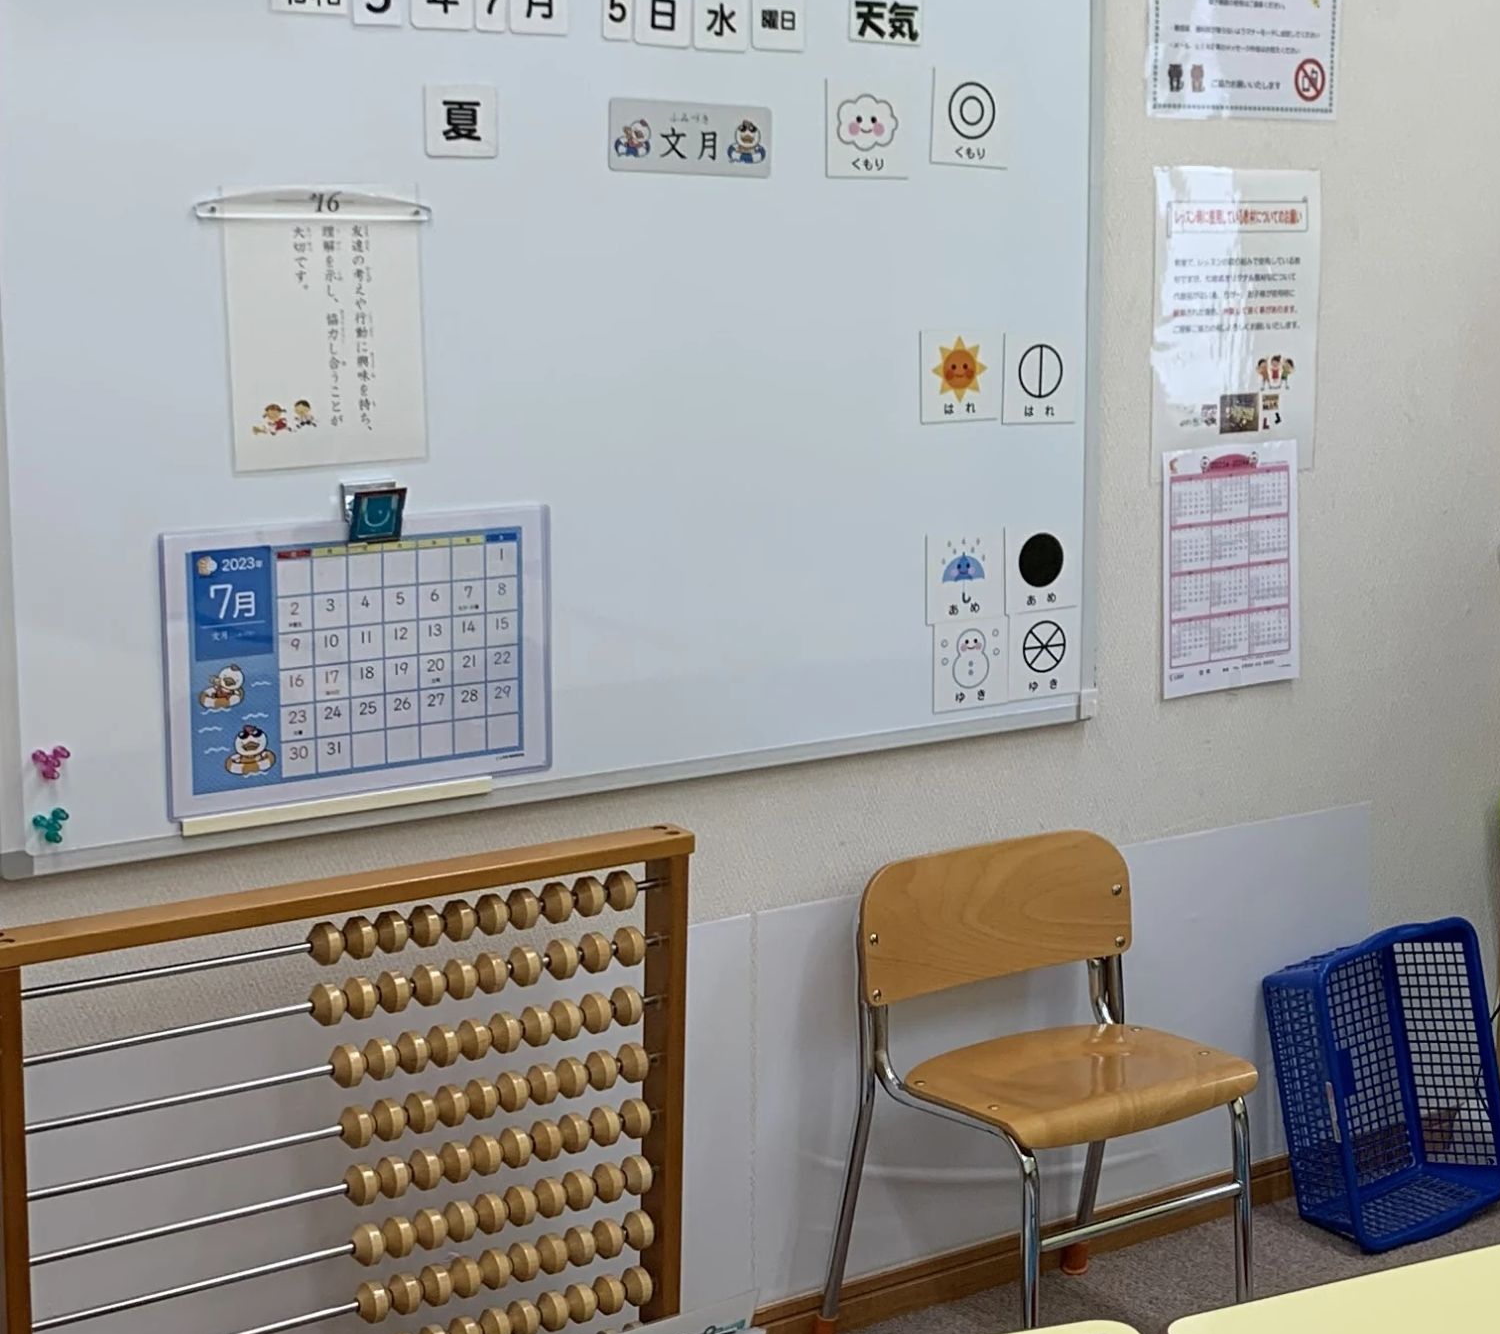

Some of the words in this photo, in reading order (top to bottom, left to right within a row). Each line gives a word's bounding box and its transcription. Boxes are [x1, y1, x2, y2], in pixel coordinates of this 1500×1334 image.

[706, 3, 737, 38] 水
[761, 9, 796, 32] 曜日
[855, 0, 919, 43] 天気
[441, 100, 482, 142] 夏
[659, 127, 719, 162] 文月
[953, 145, 987, 161] くもり
[851, 157, 885, 173] くもり
[943, 402, 977, 415] はれ
[1024, 405, 1055, 418] はれ
[209, 583, 256, 619] 7月
[289, 602, 300, 617] 2
[326, 598, 336, 612] 3
[360, 595, 370, 609] 4
[395, 592, 406, 606] 5
[430, 588, 440, 602] 6
[464, 586, 474, 599] 7
[497, 582, 507, 596] 8
[1025, 592, 1057, 606] あめ
[948, 602, 980, 617] あめ
[289, 638, 300, 651] 9
[323, 634, 339, 648] 10
[360, 630, 372, 644] 11
[393, 627, 408, 641] 12
[428, 624, 443, 637] 13
[461, 621, 476, 634] 14
[495, 617, 510, 631] 15
[289, 675, 304, 688] 16
[324, 670, 340, 684] 17
[360, 666, 375, 680] 18
[394, 663, 409, 676] 19
[427, 659, 445, 673] 20
[462, 656, 477, 669] 21
[493, 652, 511, 665] 22
[1027, 678, 1059, 692] ゆき
[288, 711, 307, 725] 23
[323, 707, 342, 721] 24
[359, 703, 377, 716] 25
[393, 698, 412, 712] 26
[427, 694, 445, 707] 27
[460, 690, 479, 703] 28
[494, 686, 512, 699] 29
[954, 689, 986, 704] ゆき
[289, 747, 309, 761] 30
[326, 743, 342, 757] 31
